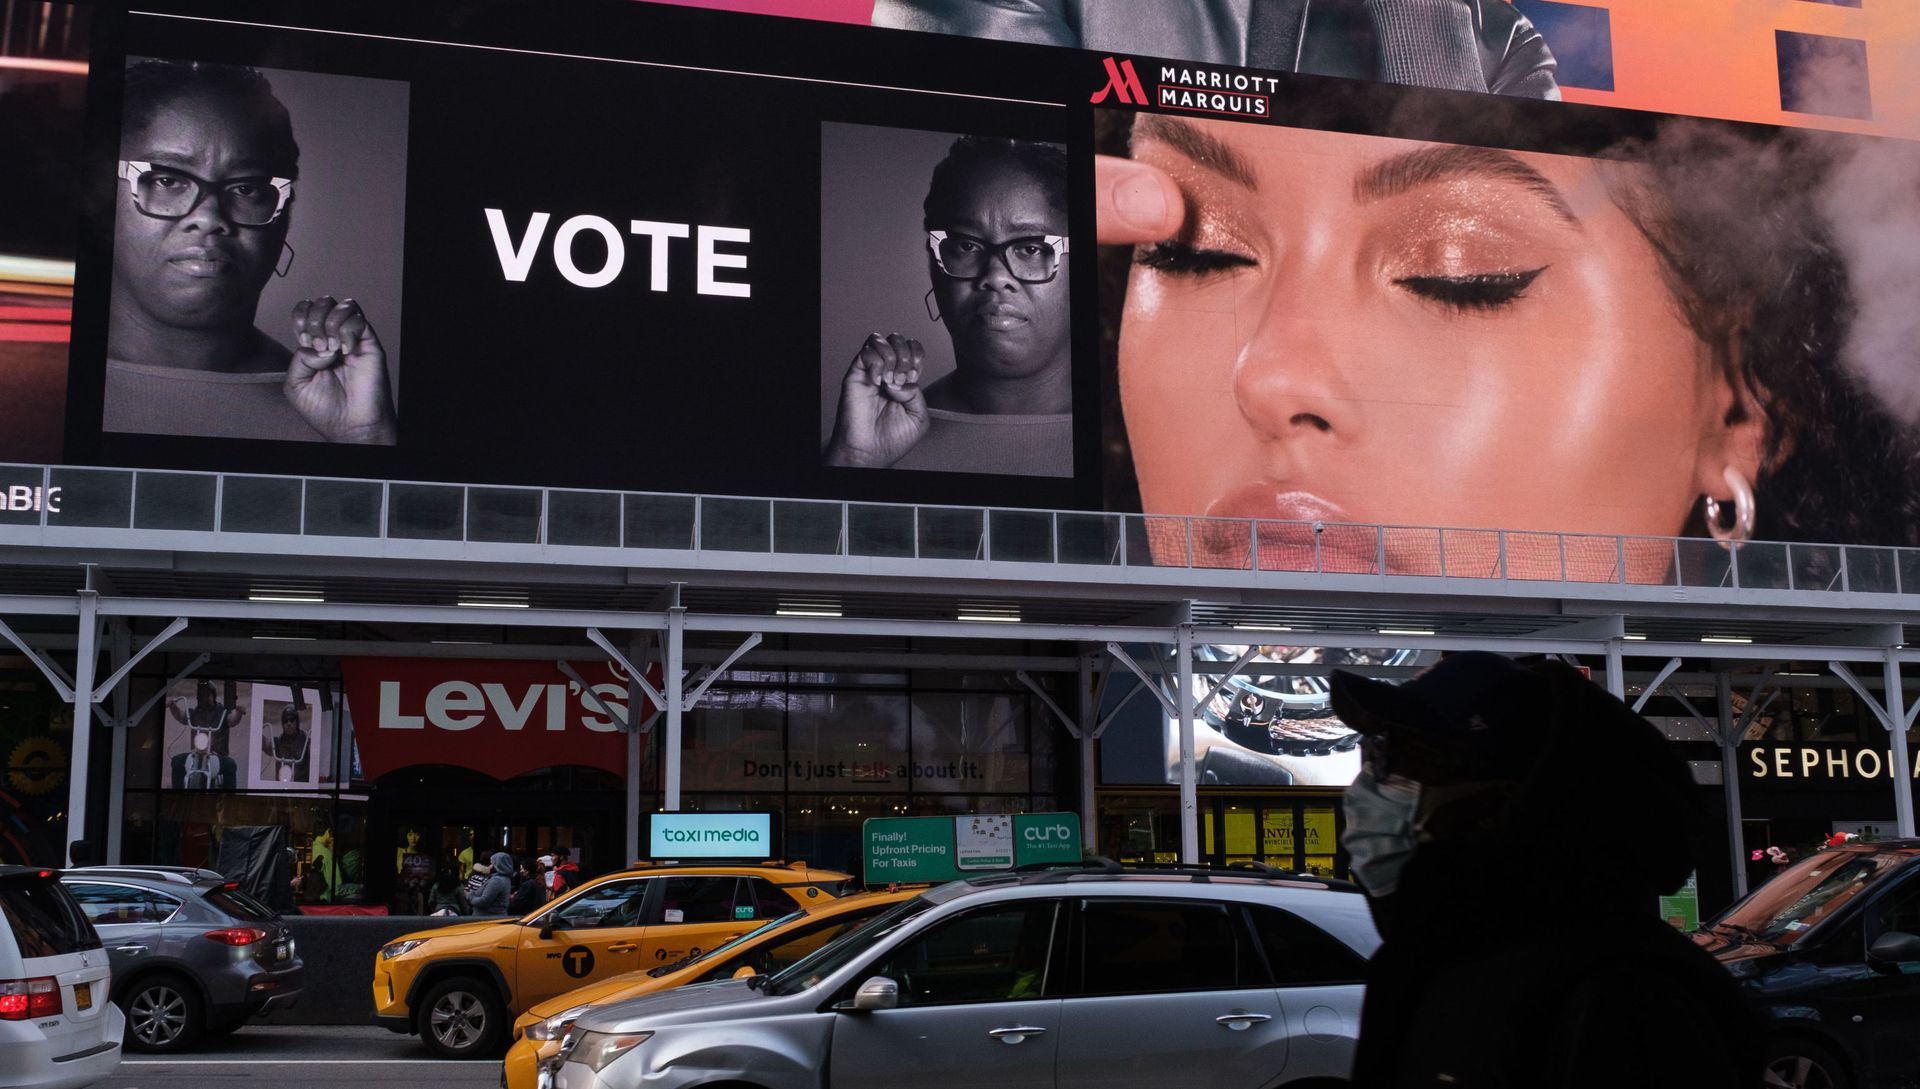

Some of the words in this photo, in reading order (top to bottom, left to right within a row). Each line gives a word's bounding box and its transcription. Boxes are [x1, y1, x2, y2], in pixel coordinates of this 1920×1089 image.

[1161, 66, 1279, 94] MARRIOTT
[1162, 89, 1266, 115] MARQUIS
[484, 208, 751, 298] VOTE
[743, 760, 802, 778] Don't
[805, 760, 845, 781] just
[897, 760, 957, 779] about
[963, 760, 984, 779] it.
[1751, 747, 1920, 779] SEPHO
[663, 828, 700, 842] taxi
[704, 828, 759, 842] media
[871, 832, 907, 843] Finally!
[1024, 824, 1071, 841] curb
[1264, 828, 1319, 838] INVITA
[872, 844, 911, 856] Upfront
[911, 843, 946, 856] Pricing
[1058, 843, 1071, 851] App
[872, 858, 890, 868] For
[890, 857, 917, 868] Taxis
[570, 951, 588, 975] T
